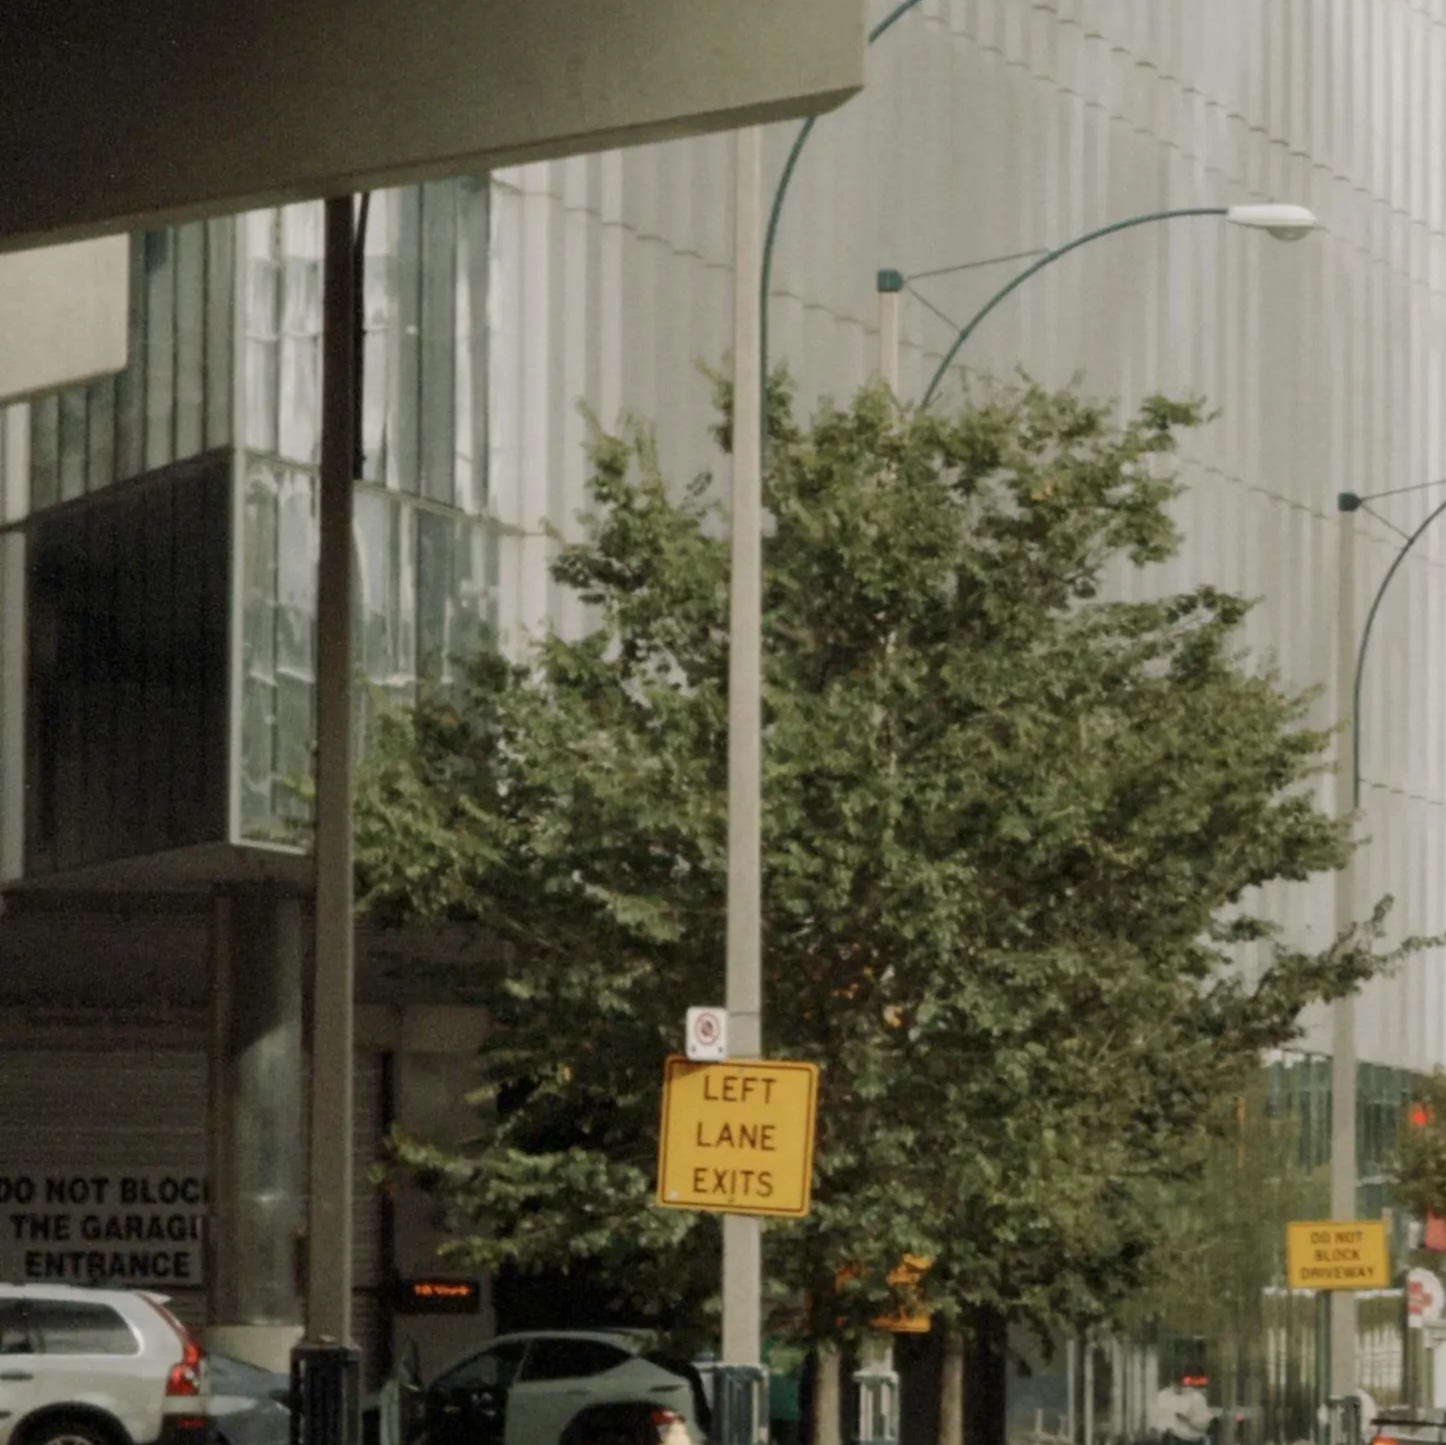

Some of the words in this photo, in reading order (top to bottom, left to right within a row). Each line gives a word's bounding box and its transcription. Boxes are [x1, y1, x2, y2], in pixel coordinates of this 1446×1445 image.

[703, 1074, 777, 1104] LEFT
[696, 1121, 776, 1151] LANE
[0, 1176, 35, 1204] DO
[45, 1176, 109, 1204] NOT
[692, 1167, 774, 1198] EXITS
[10, 1214, 72, 1241] THE
[1310, 1231, 1331, 1244] DO
[1335, 1230, 1363, 1244] NOT
[25, 1251, 191, 1278] ENTRANCE
[1314, 1249, 1361, 1262] BLOCK
[1300, 1266, 1375, 1280] DRIVEWAY
